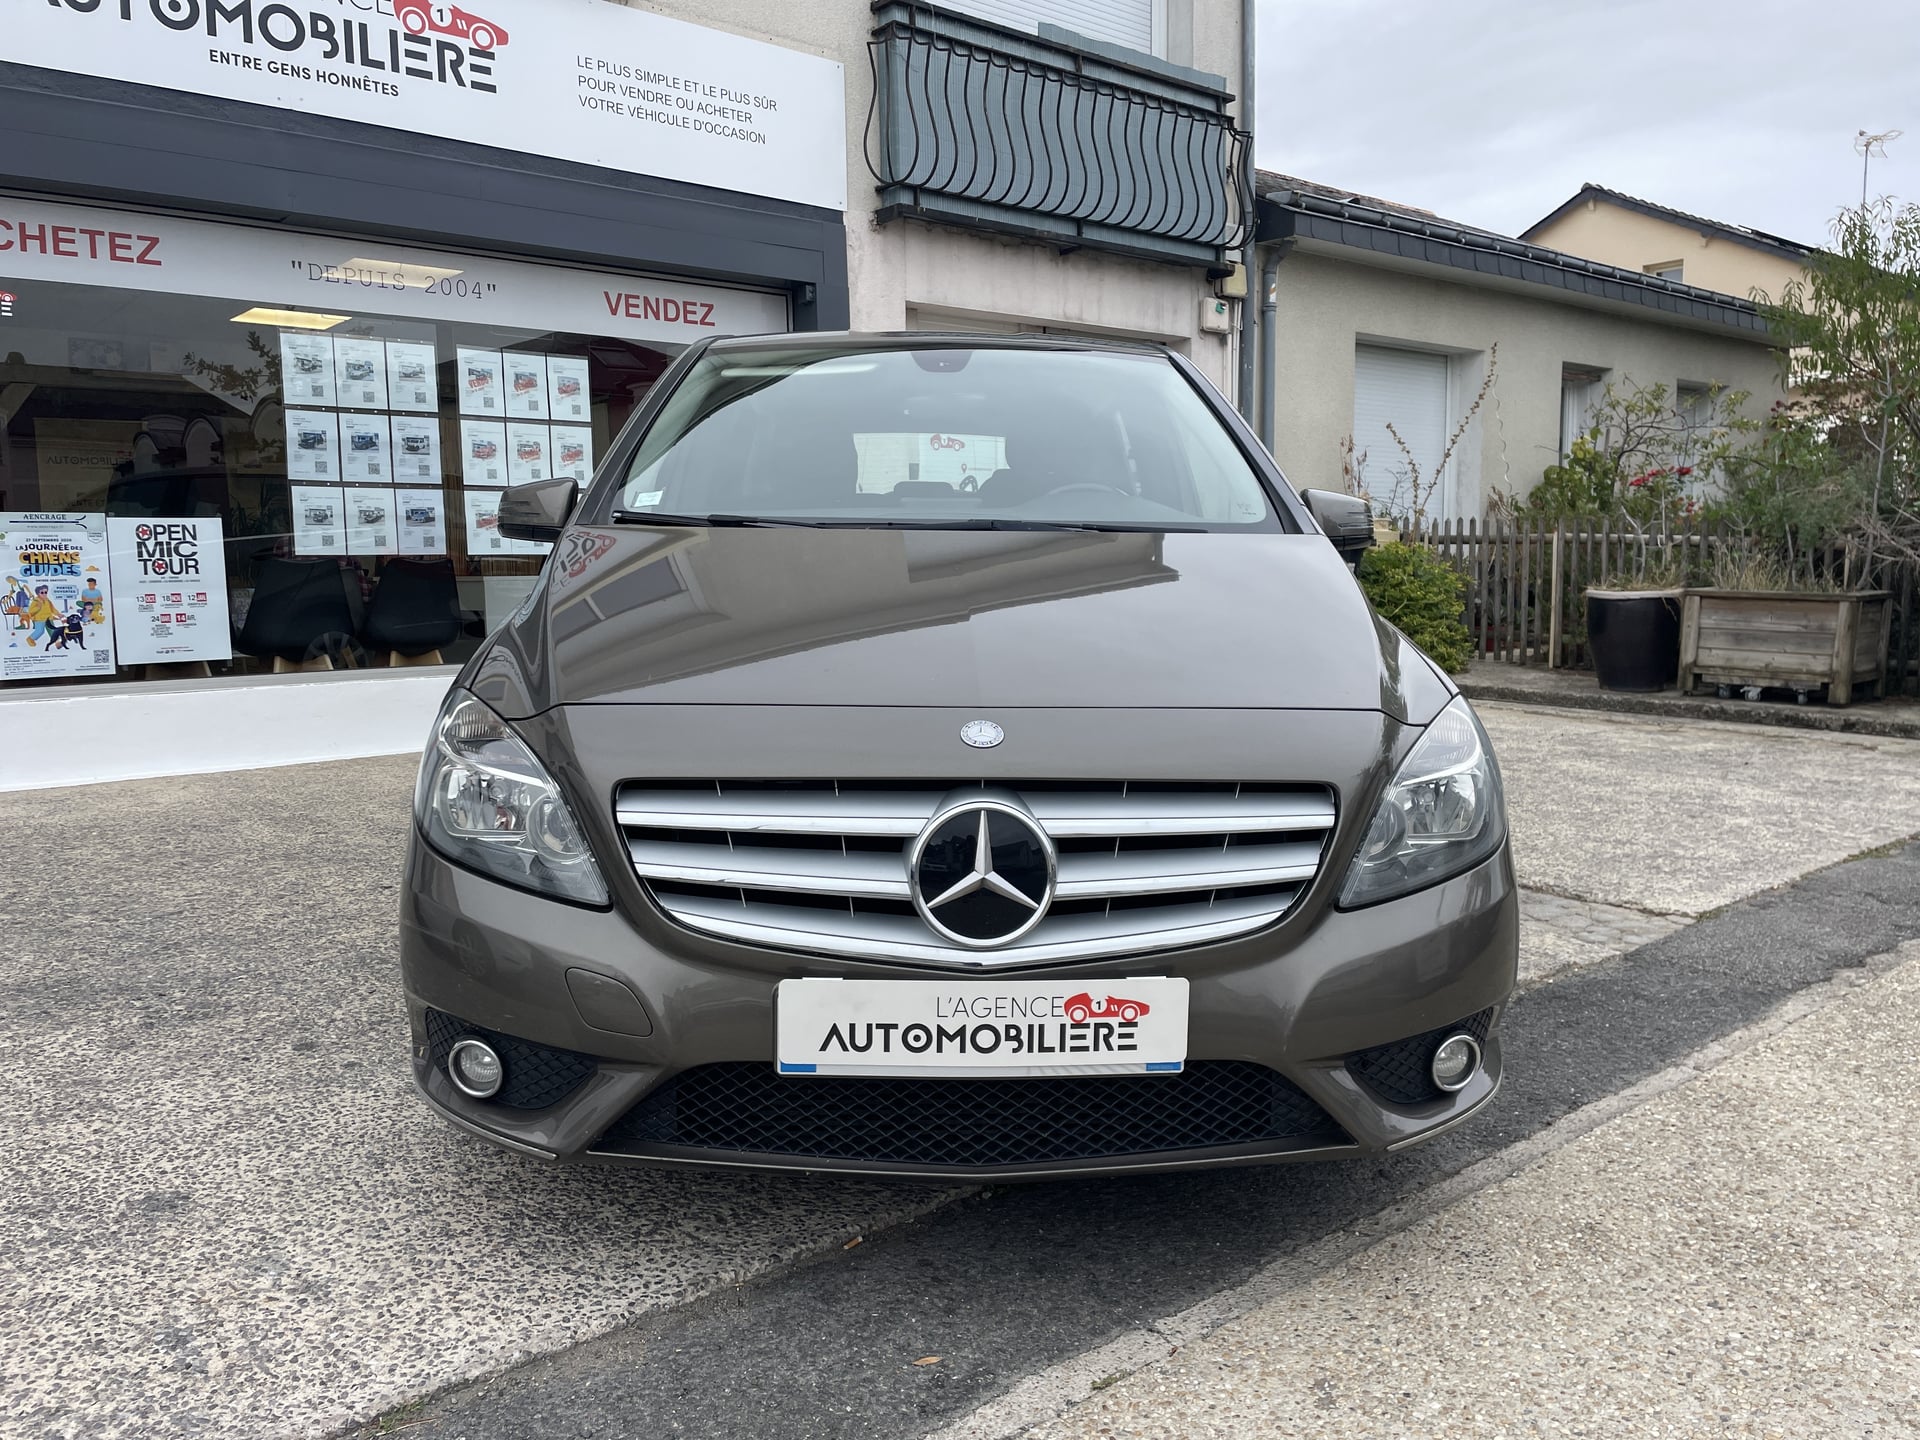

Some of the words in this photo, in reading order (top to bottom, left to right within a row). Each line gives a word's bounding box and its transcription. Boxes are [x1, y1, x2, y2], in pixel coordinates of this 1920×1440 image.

[45, 0, 497, 94] OMOBILIERE
[209, 49, 263, 71] ENTRE
[267, 60, 311, 80] GENS
[316, 69, 399, 97] HONNÊTES
[577, 55, 593, 70] LE
[597, 60, 631, 78] PLUS
[634, 68, 681, 90] SIMPLE
[684, 79, 699, 93] ET
[702, 83, 717, 98] LE
[720, 88, 751, 106] PLUS
[753, 95, 777, 112] SÛR
[578, 75, 617, 95] POUR
[619, 84, 673, 107] VENDRE
[675, 96, 694, 111] OU
[696, 101, 753, 124] ACHETER
[578, 94, 624, 116] VOTRE
[627, 103, 690, 129] VÉHICULE
[693, 119, 766, 145] D'OCCASION
[291, 260, 405, 291] "DEPUIS
[424, 275, 497, 299] 2004"
[603, 291, 715, 327] VENDEZ
[135, 523, 197, 542] OPEN
[18, 551, 81, 564] CHIENS
[24, 542, 70, 551] JOURNÉE
[136, 541, 198, 558] MIC
[19, 564, 82, 577] GUIDES
[137, 558, 200, 576] TOUR
[936, 996, 1065, 1018] L'AGENCE
[1095, 1000, 1102, 1011] 1
[818, 1021, 1139, 1054] AUTOMOBILIERE
